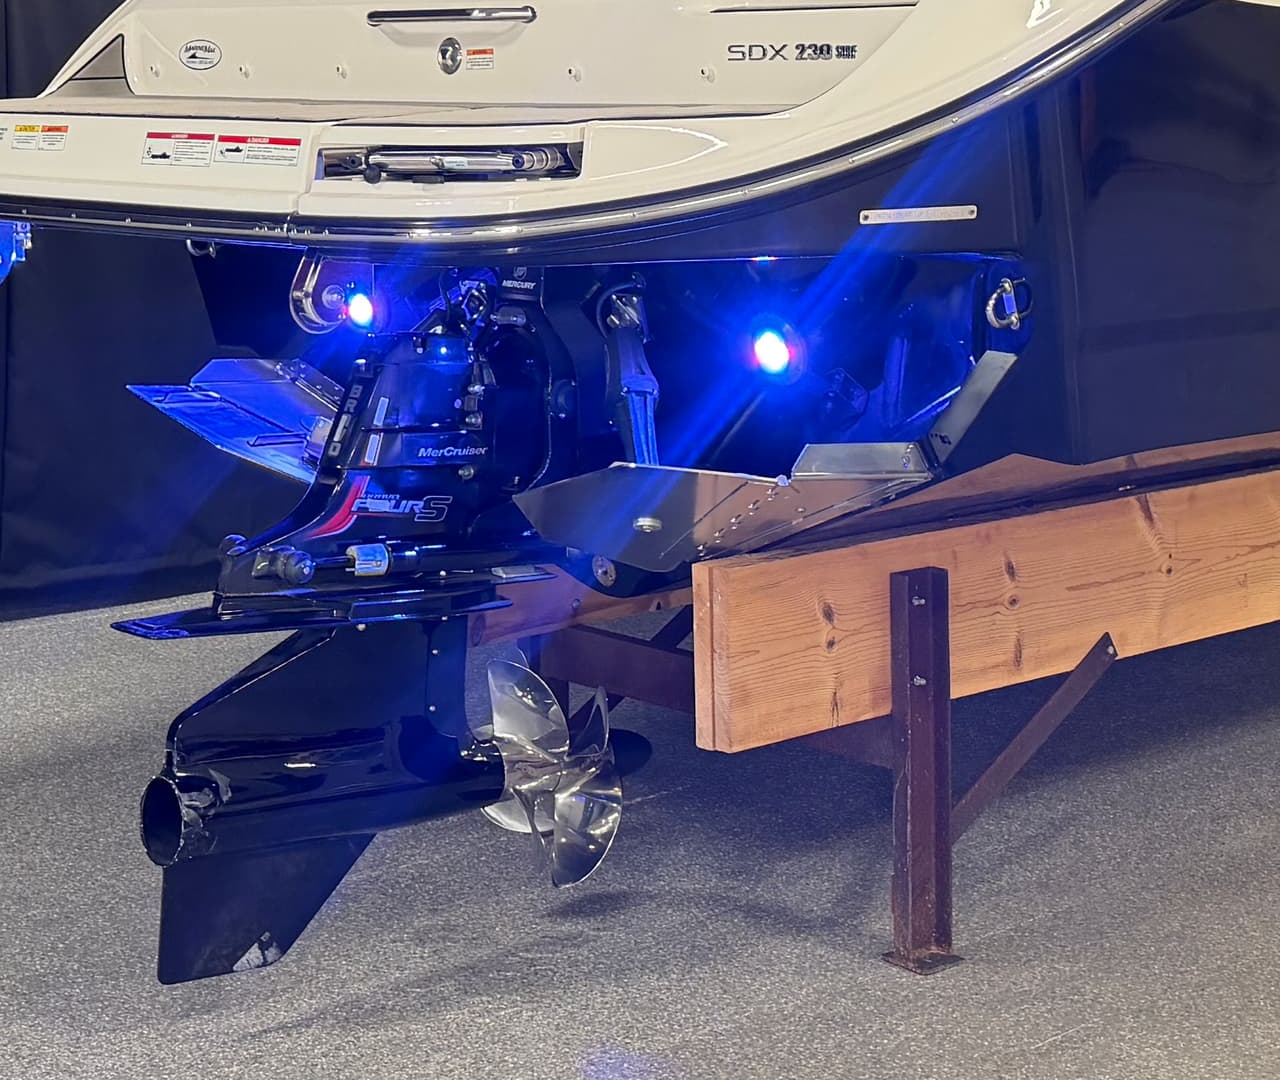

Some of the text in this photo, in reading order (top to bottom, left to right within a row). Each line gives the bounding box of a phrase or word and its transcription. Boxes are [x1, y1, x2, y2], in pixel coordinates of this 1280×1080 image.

[728, 44, 788, 61] SDX
[795, 43, 832, 60] 230
[502, 280, 537, 290] MERCURY
[418, 446, 488, 457] MerCruiser
